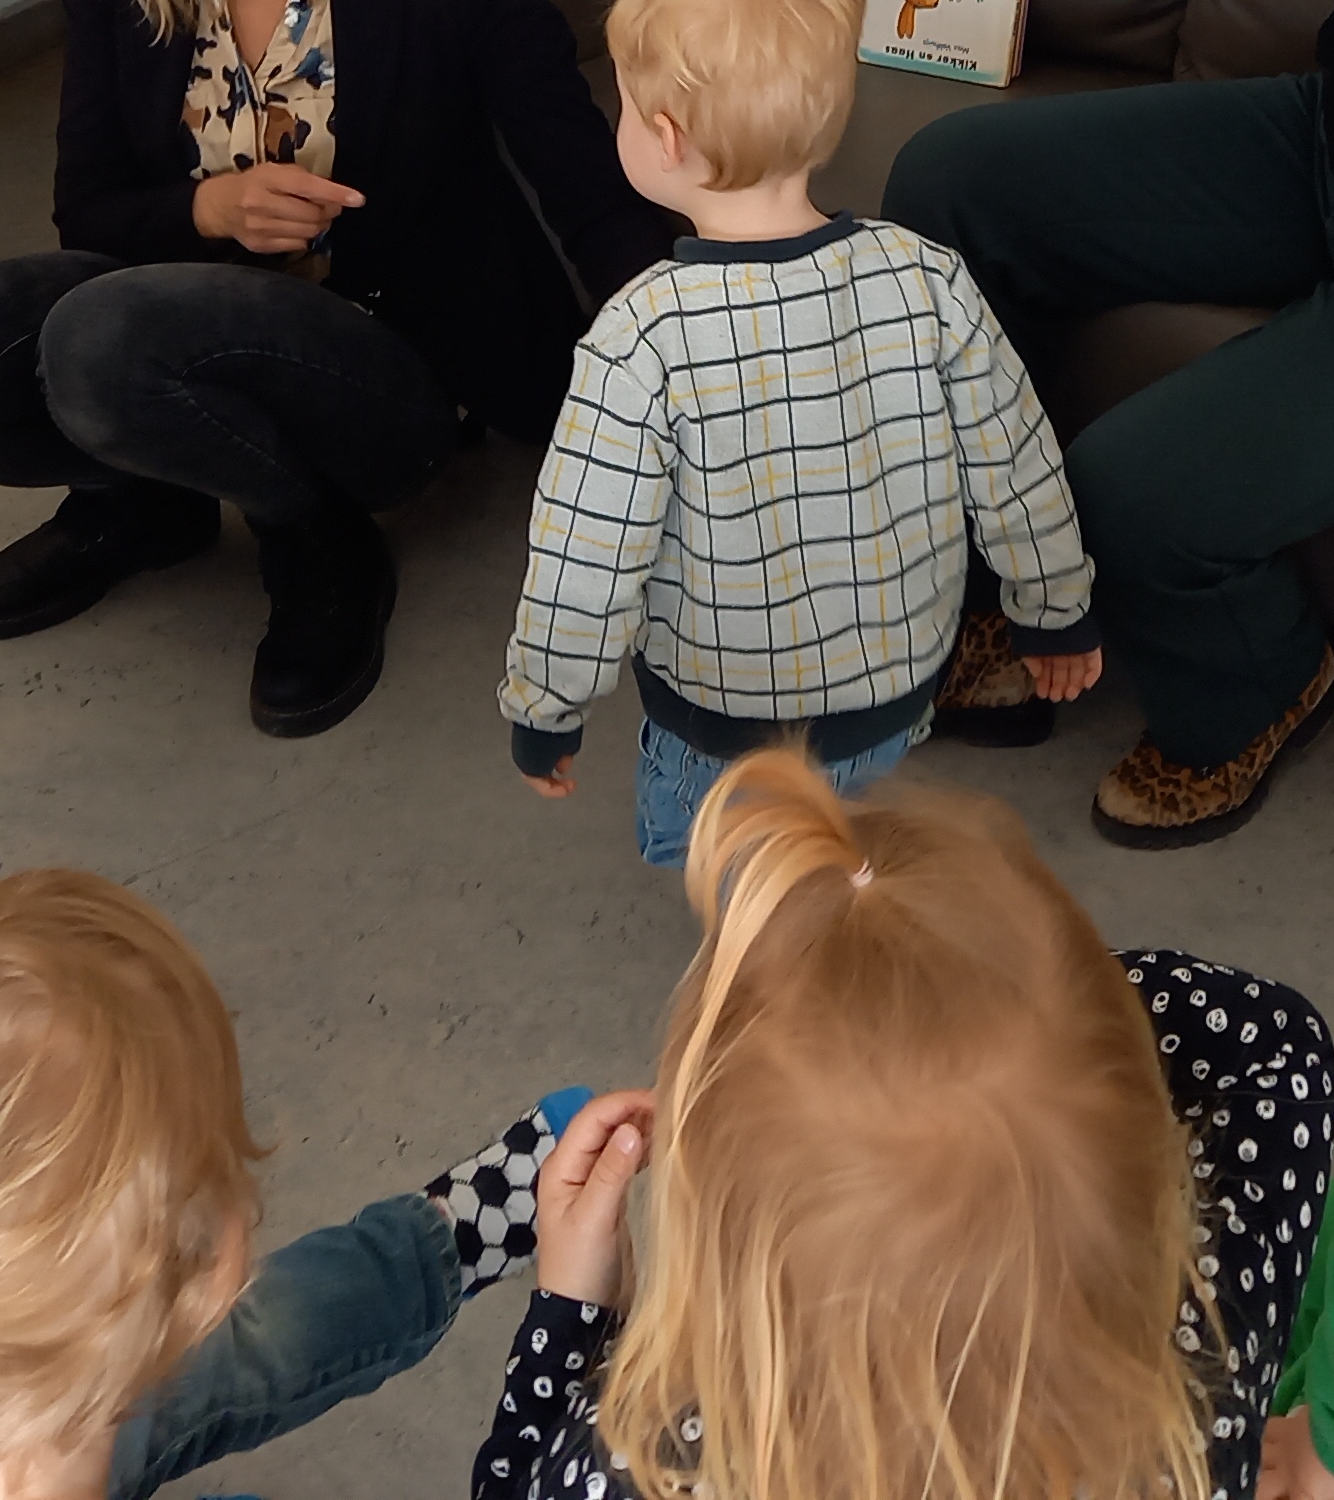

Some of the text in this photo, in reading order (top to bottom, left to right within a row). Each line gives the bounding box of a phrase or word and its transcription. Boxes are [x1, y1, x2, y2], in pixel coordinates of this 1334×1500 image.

[885, 45, 978, 72] Kikker en Haas
